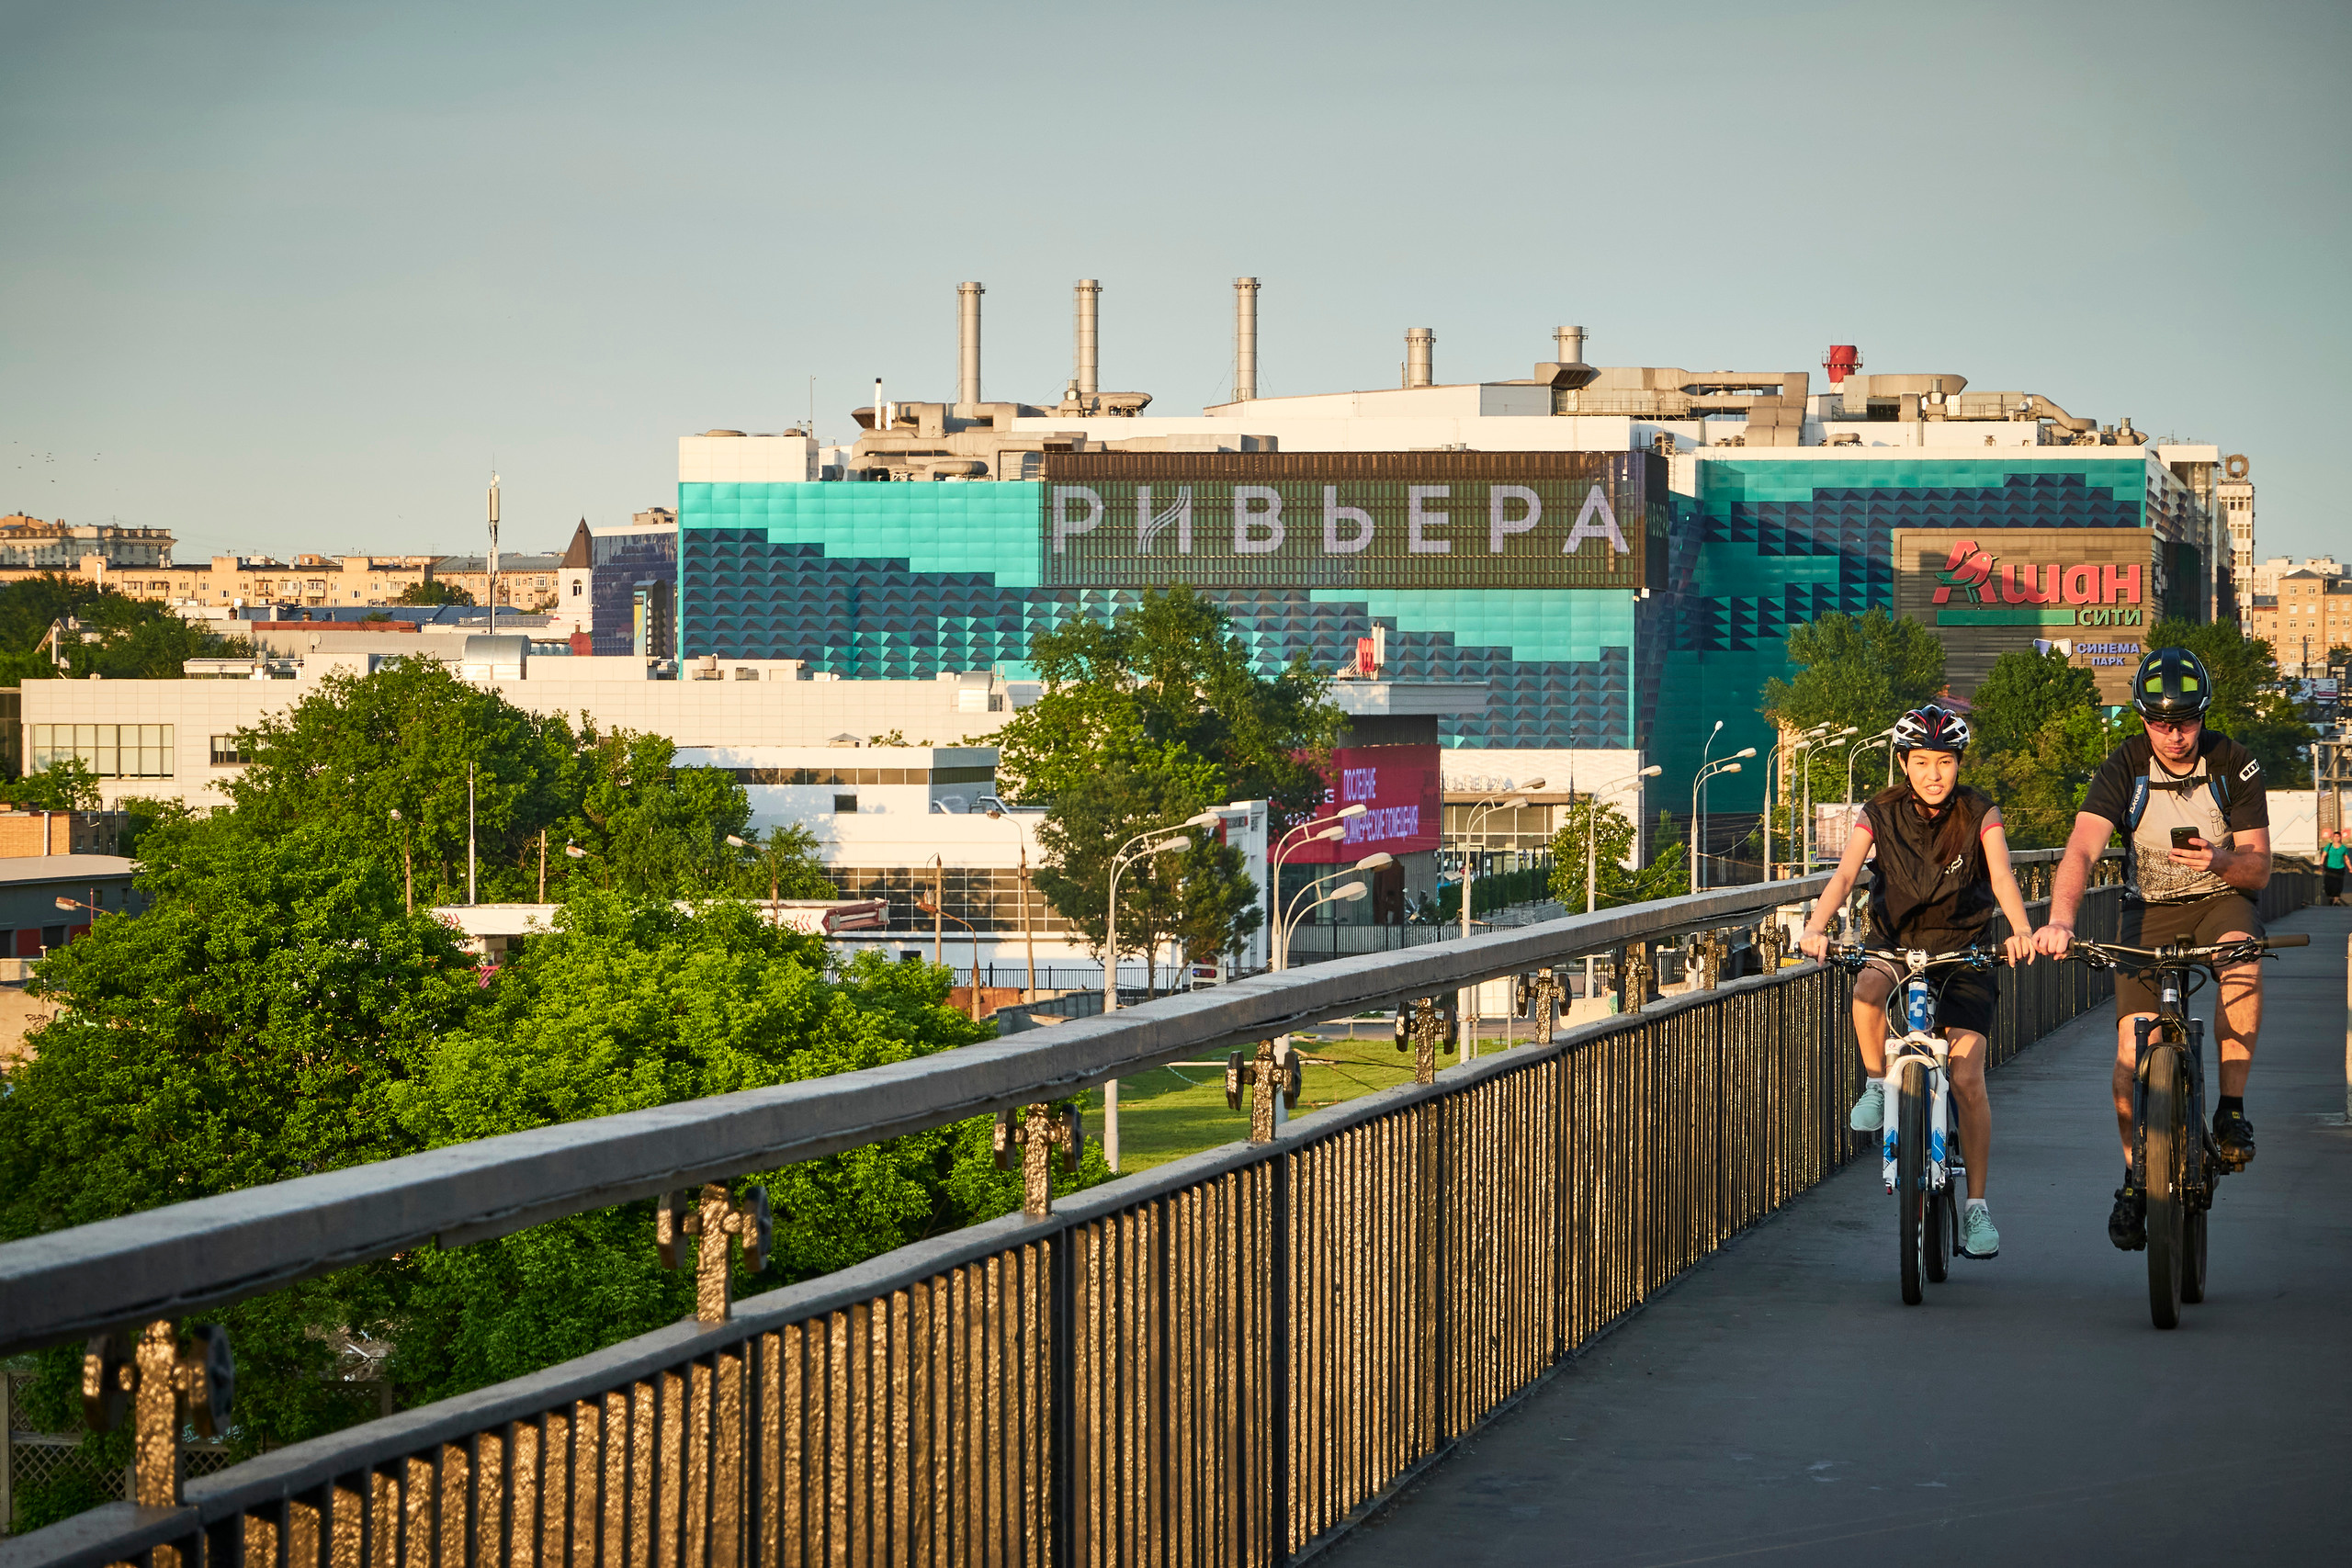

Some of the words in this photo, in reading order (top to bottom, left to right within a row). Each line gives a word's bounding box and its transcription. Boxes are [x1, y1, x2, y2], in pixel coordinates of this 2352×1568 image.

[1052, 484, 1631, 555] РИВЬЕРА
[2079, 609, 2142, 626] СИТИ
[2076, 643, 2140, 654] СИНЕМА
[2092, 657, 2125, 666] ПАРК
